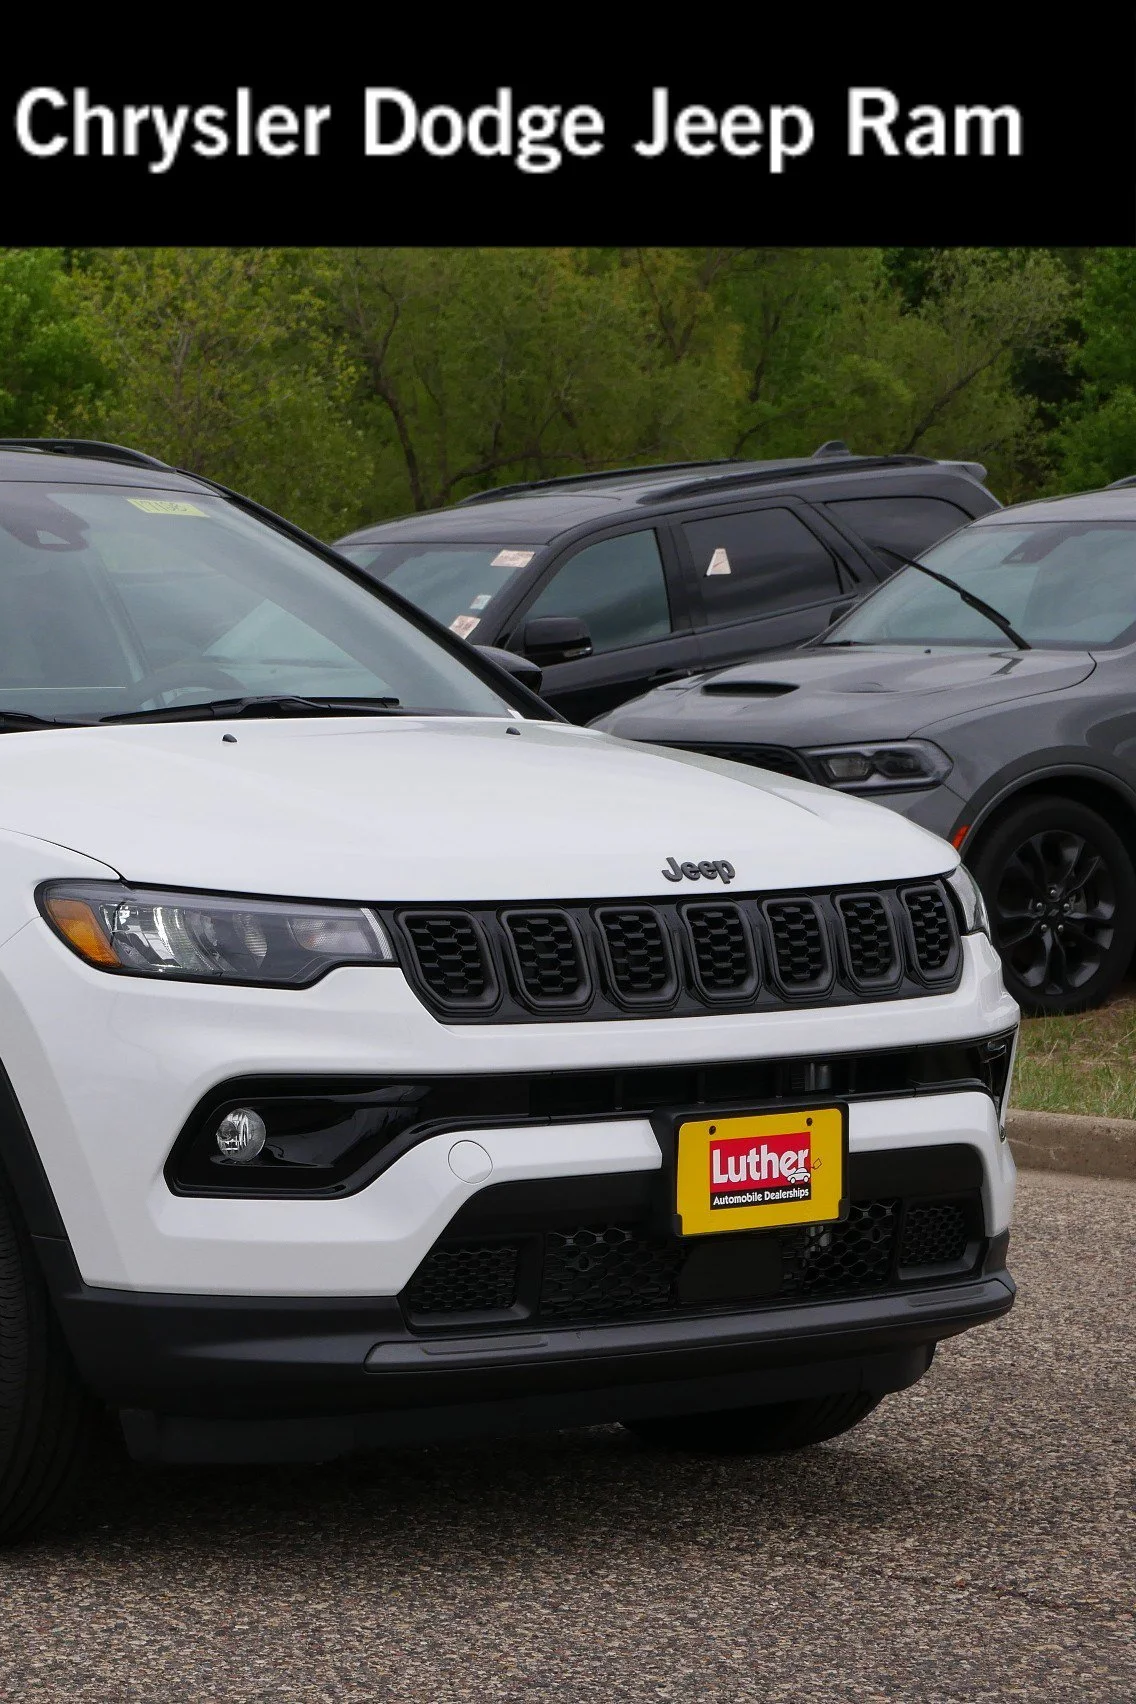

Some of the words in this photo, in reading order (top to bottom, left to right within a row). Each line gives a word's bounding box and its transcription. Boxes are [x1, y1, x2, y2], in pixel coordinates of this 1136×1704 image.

[661, 857, 736, 884] Jeep
[712, 1144, 810, 1184] Luther
[713, 1192, 763, 1206] Automobile
[764, 1187, 810, 1201] Dealerships
